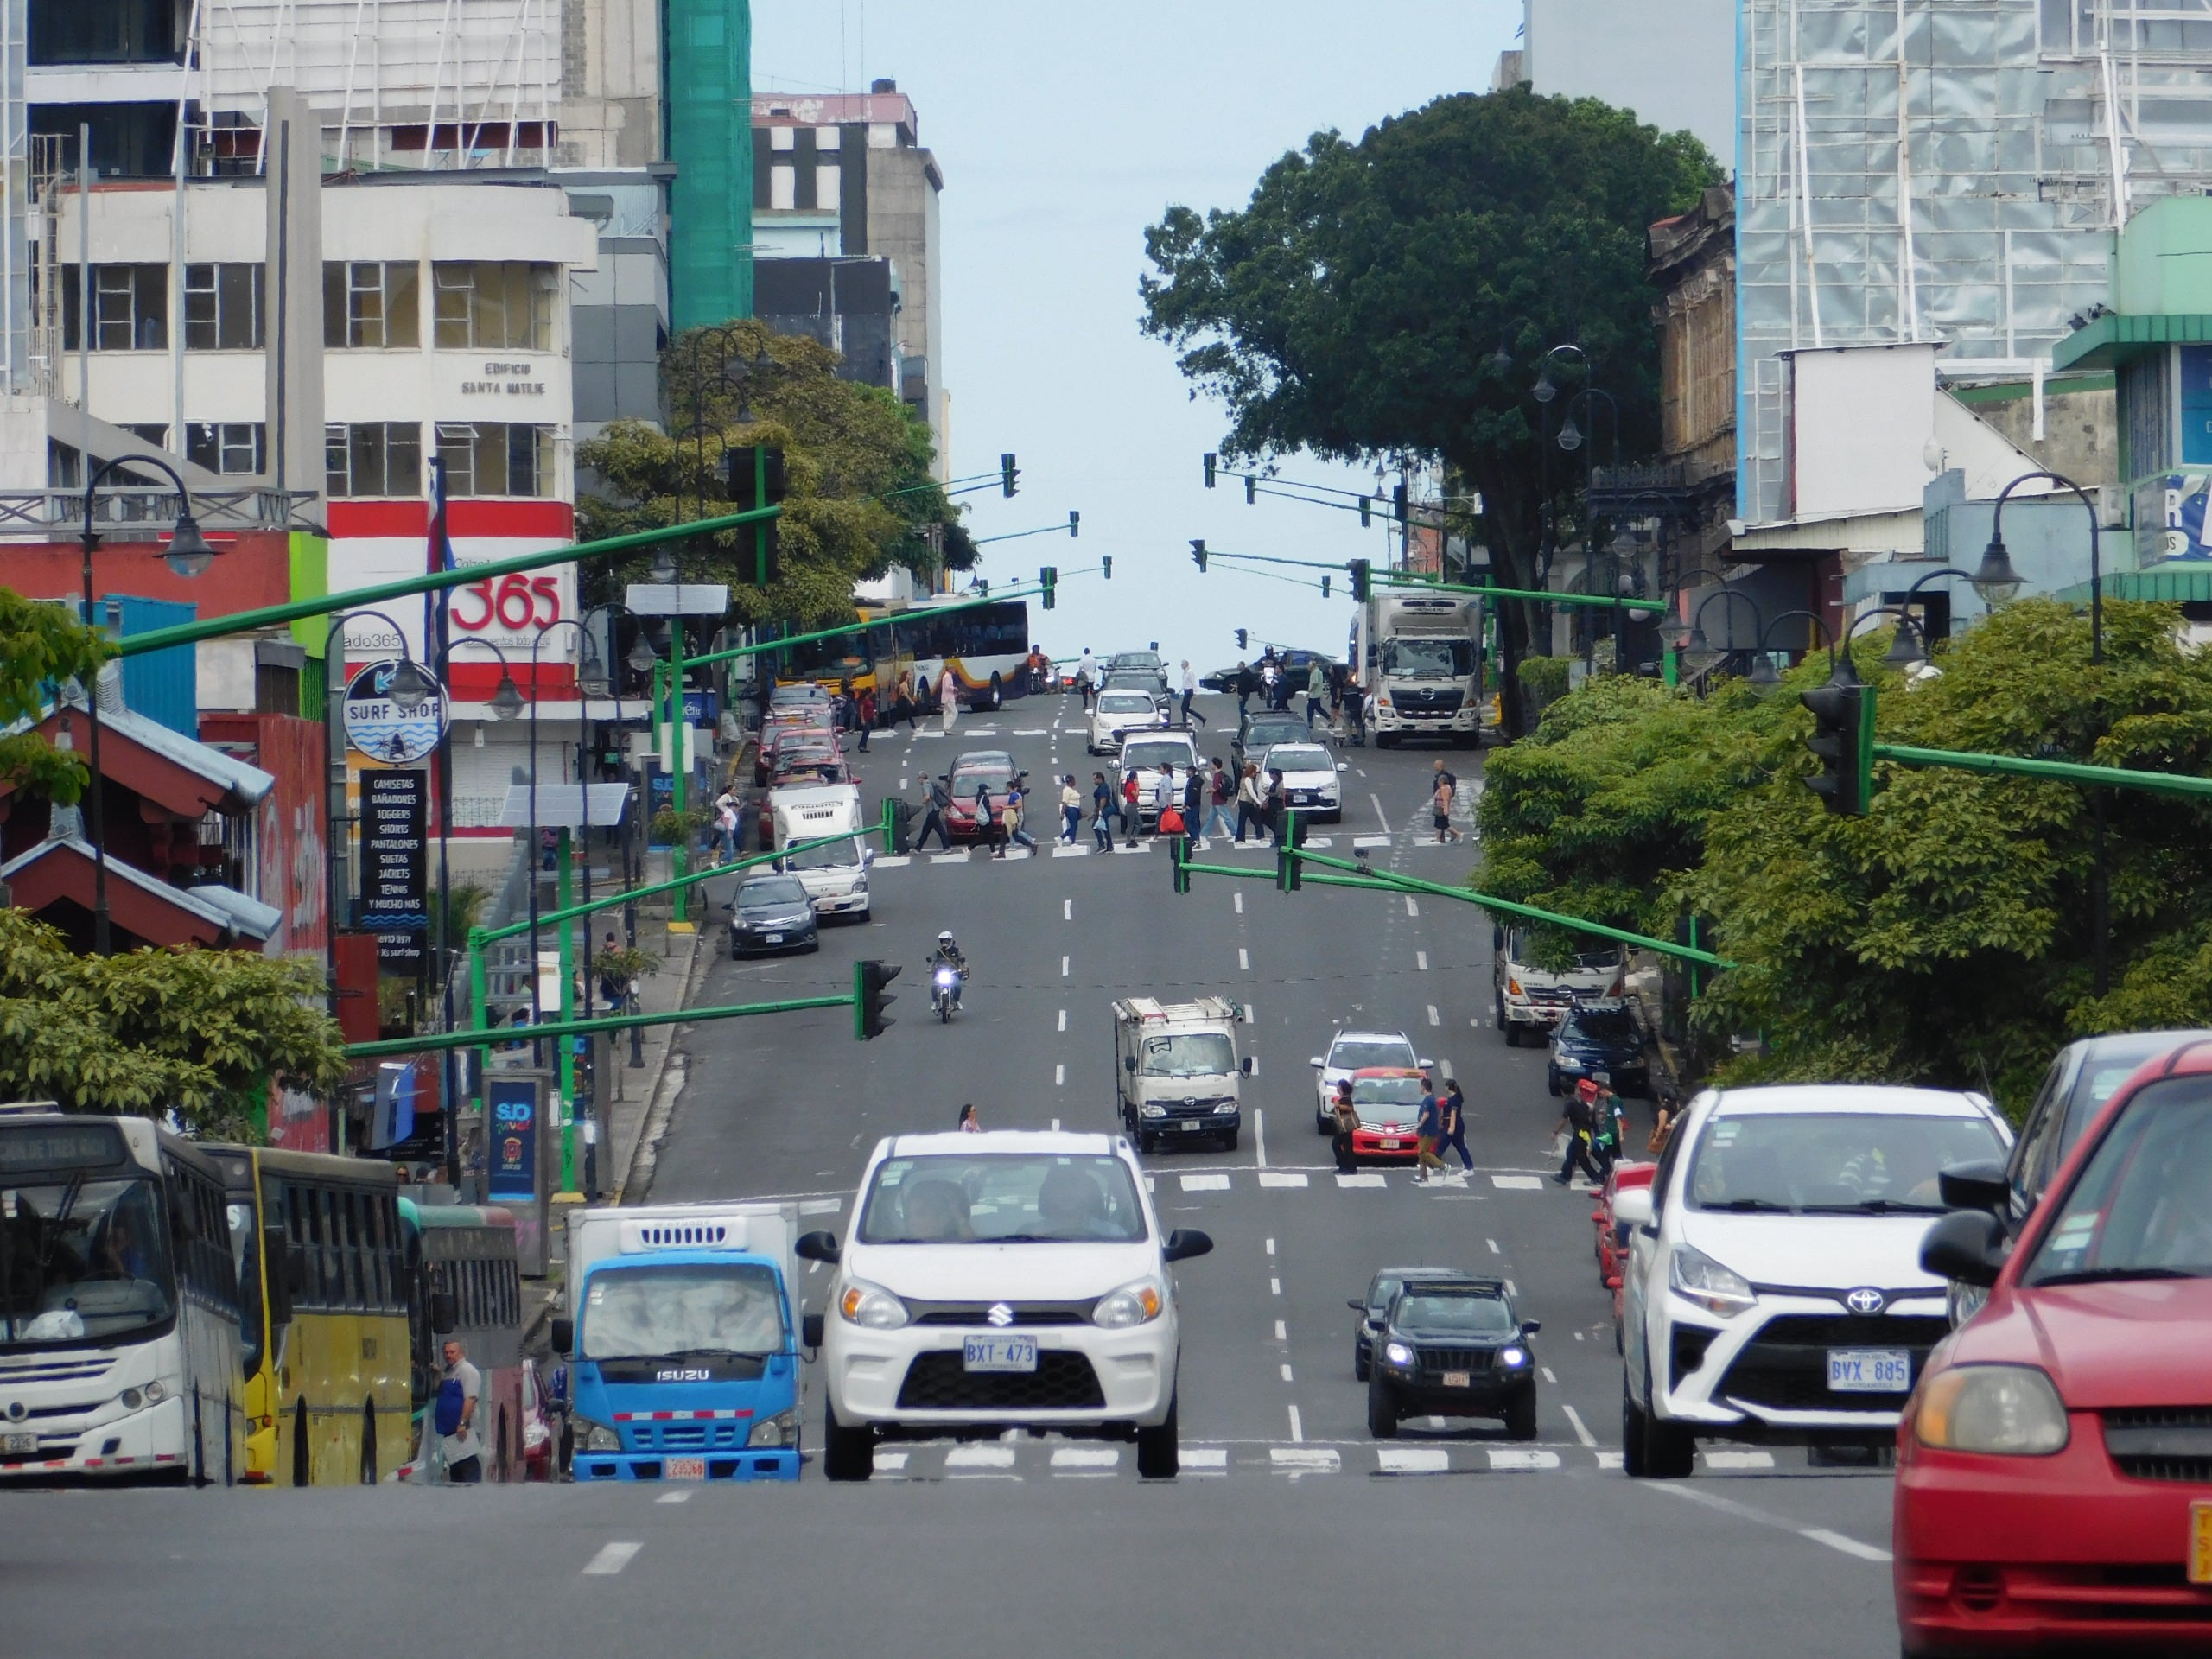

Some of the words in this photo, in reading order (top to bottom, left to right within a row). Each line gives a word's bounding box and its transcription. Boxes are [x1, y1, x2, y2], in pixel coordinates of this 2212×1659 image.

[485, 362, 531, 375] EDIFICIO
[461, 381, 501, 394] SANTA
[450, 573, 560, 631] 365
[349, 704, 390, 720] SURF
[398, 702, 440, 719] SHOP
[373, 779, 415, 789] CAMISETAS
[372, 793, 416, 804] BAÑADORES
[377, 809, 411, 819] JOGGERS
[379, 823, 409, 834] SHORTS
[370, 839, 418, 849] PANTALONES
[380, 854, 408, 864] SUETAS
[378, 868, 410, 879] JACKETS
[368, 899, 375, 909] Y
[375, 899, 403, 909] MUCHO
[968, 1344, 1033, 1363] BXT-473
[657, 1369, 709, 1382] ISUZU
[1833, 1361, 1905, 1381] BVX-885
